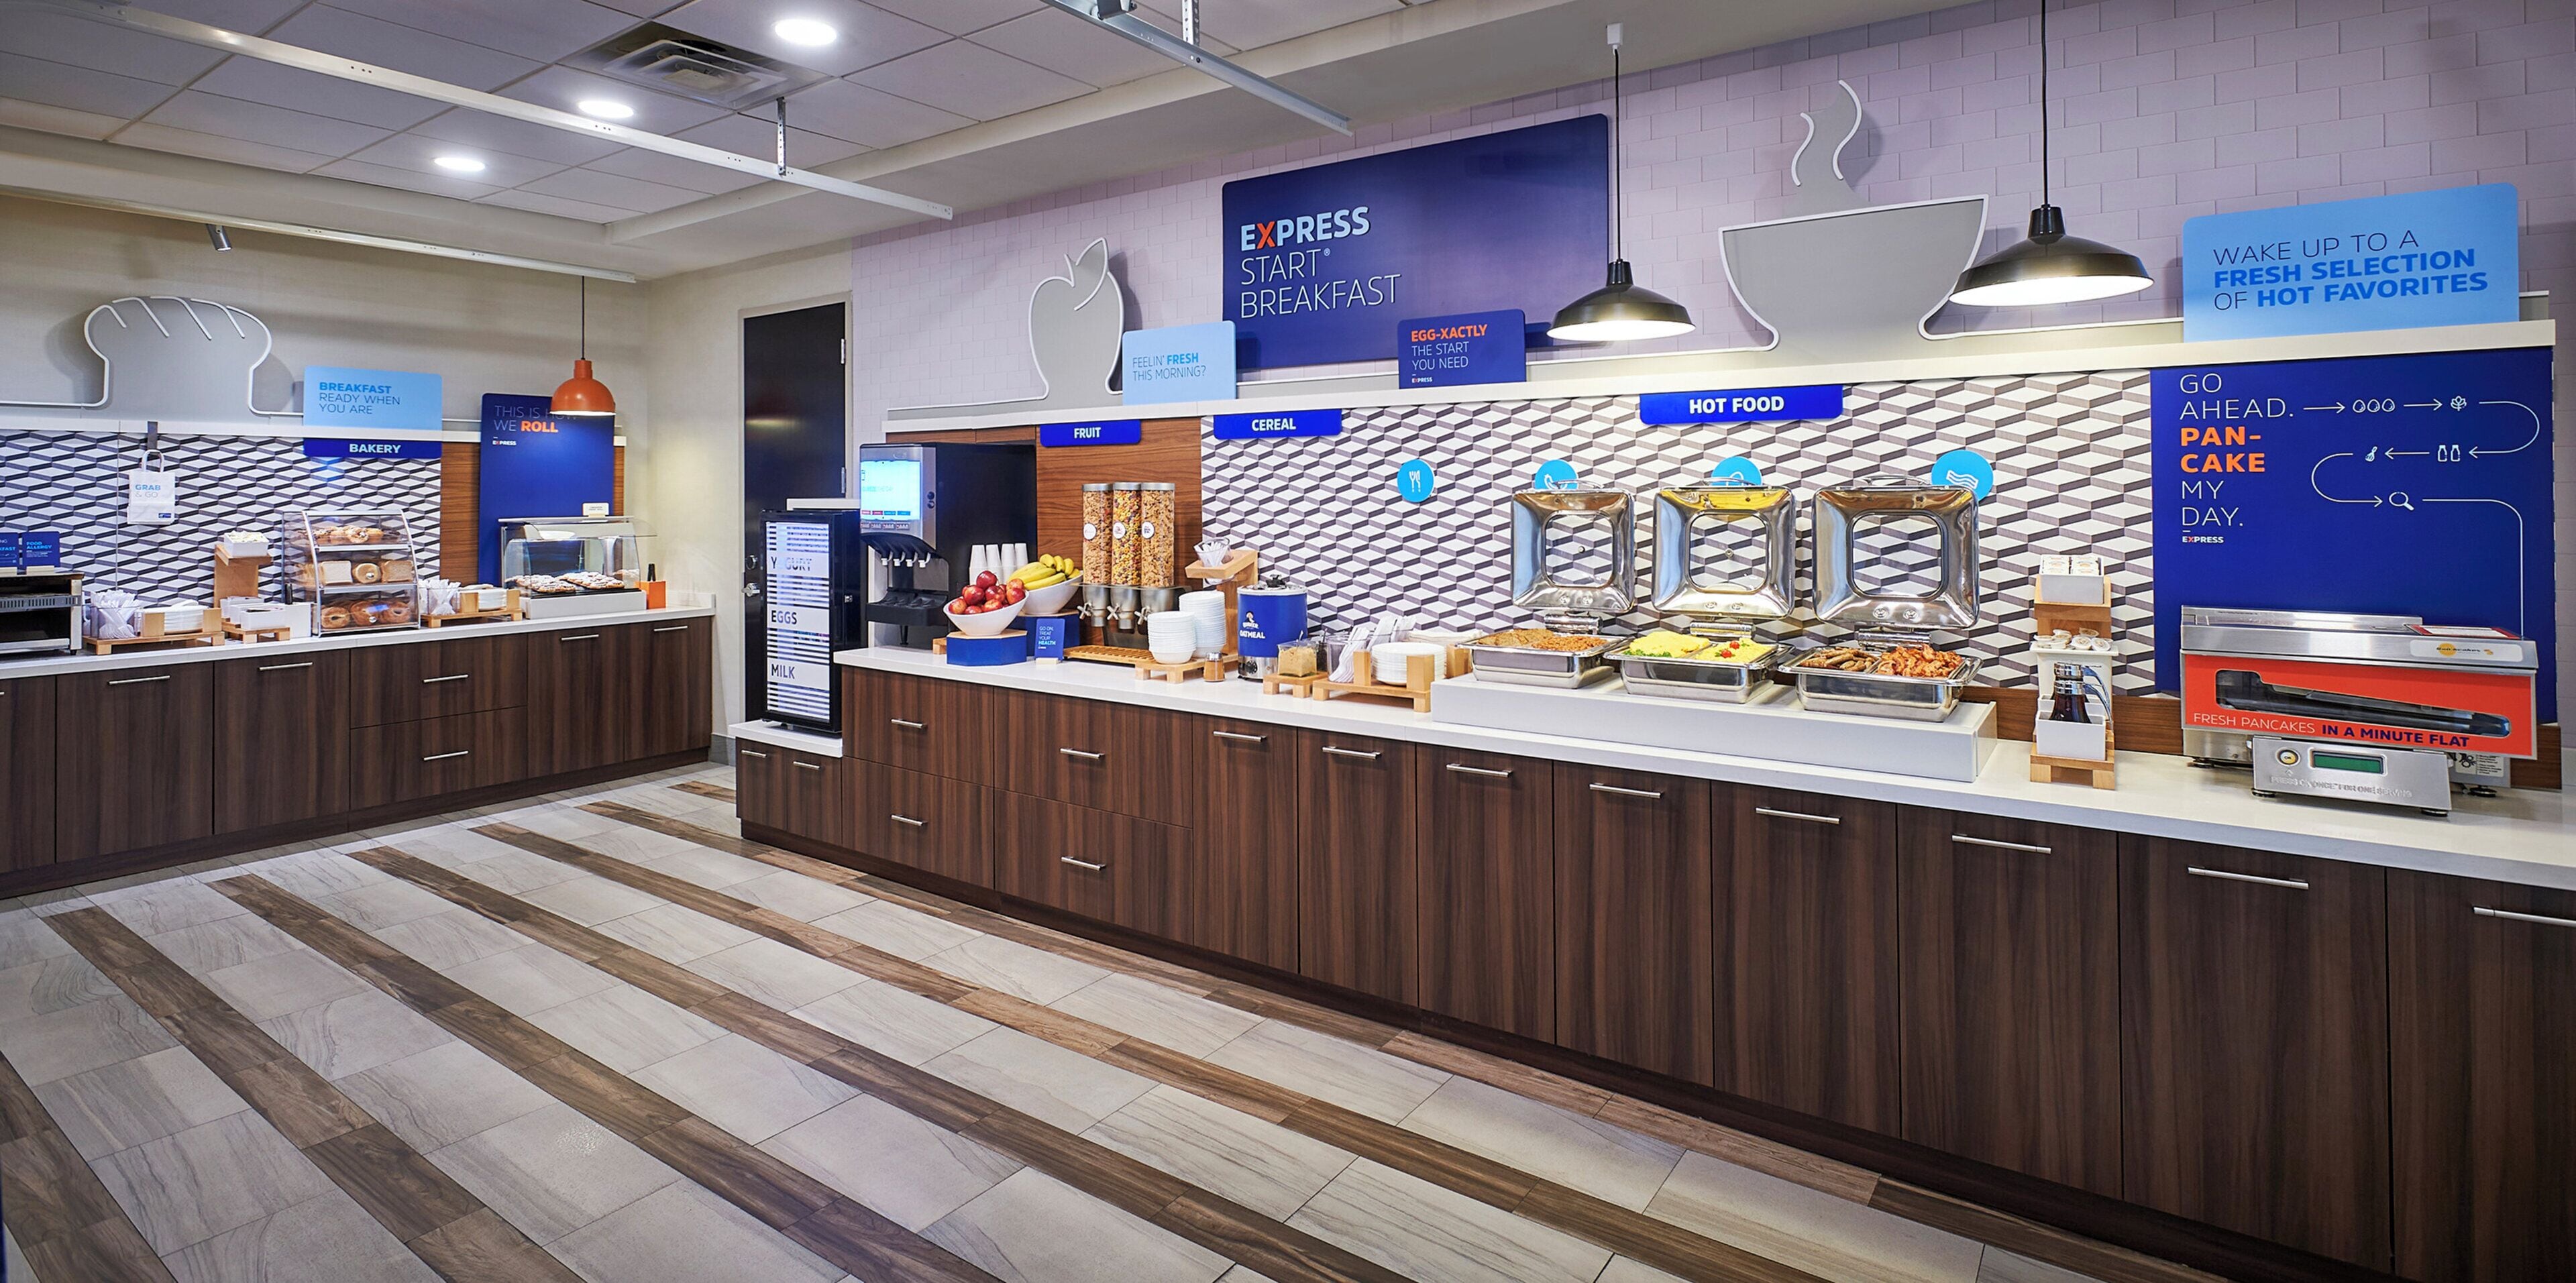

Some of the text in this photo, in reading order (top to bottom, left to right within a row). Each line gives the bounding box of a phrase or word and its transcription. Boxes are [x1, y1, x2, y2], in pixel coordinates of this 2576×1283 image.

[1241, 206, 1371, 252] EXPRESS
[2213, 229, 2419, 266] WAKE UP TO A
[2214, 248, 2475, 288] FRESH SELECTION
[1241, 274, 1402, 319] BREAKFAST
[2214, 272, 2488, 311] OF HOT FAVORITES
[1411, 323, 1488, 342] EGG-XACTLY
[1411, 341, 1469, 356] THE START
[1132, 352, 1199, 368] FEELIN' FRESH
[1411, 356, 1468, 370] YOU NEED
[1133, 365, 1206, 381] THIS MORNING?
[319, 382, 392, 394] BREAKFAST
[2180, 373, 2222, 394] GO
[319, 392, 400, 405] READY WHEN
[1689, 396, 1784, 414] HOT FOOD
[319, 403, 373, 414] YOU ARE
[494, 405, 525, 418] THIS
[529, 407, 541, 419] IS
[2180, 398, 2294, 420] AHEAD.
[493, 420, 559, 433] WE ROLL
[1074, 427, 1102, 439] FRUIT
[1251, 418, 1297, 432] CEREAL
[2180, 426, 2261, 447] PAN-
[350, 443, 401, 453] BAKERY
[2180, 453, 2265, 473] CAKE
[2182, 480, 2224, 499] MY
[2182, 506, 2243, 526] DAY.
[771, 610, 797, 624] EGGS
[1239, 630, 1266, 638] OATMEAL
[771, 663, 795, 679] MILK
[2194, 713, 2470, 746] FRESH PANCAKES IN A MINUTE FLAT
